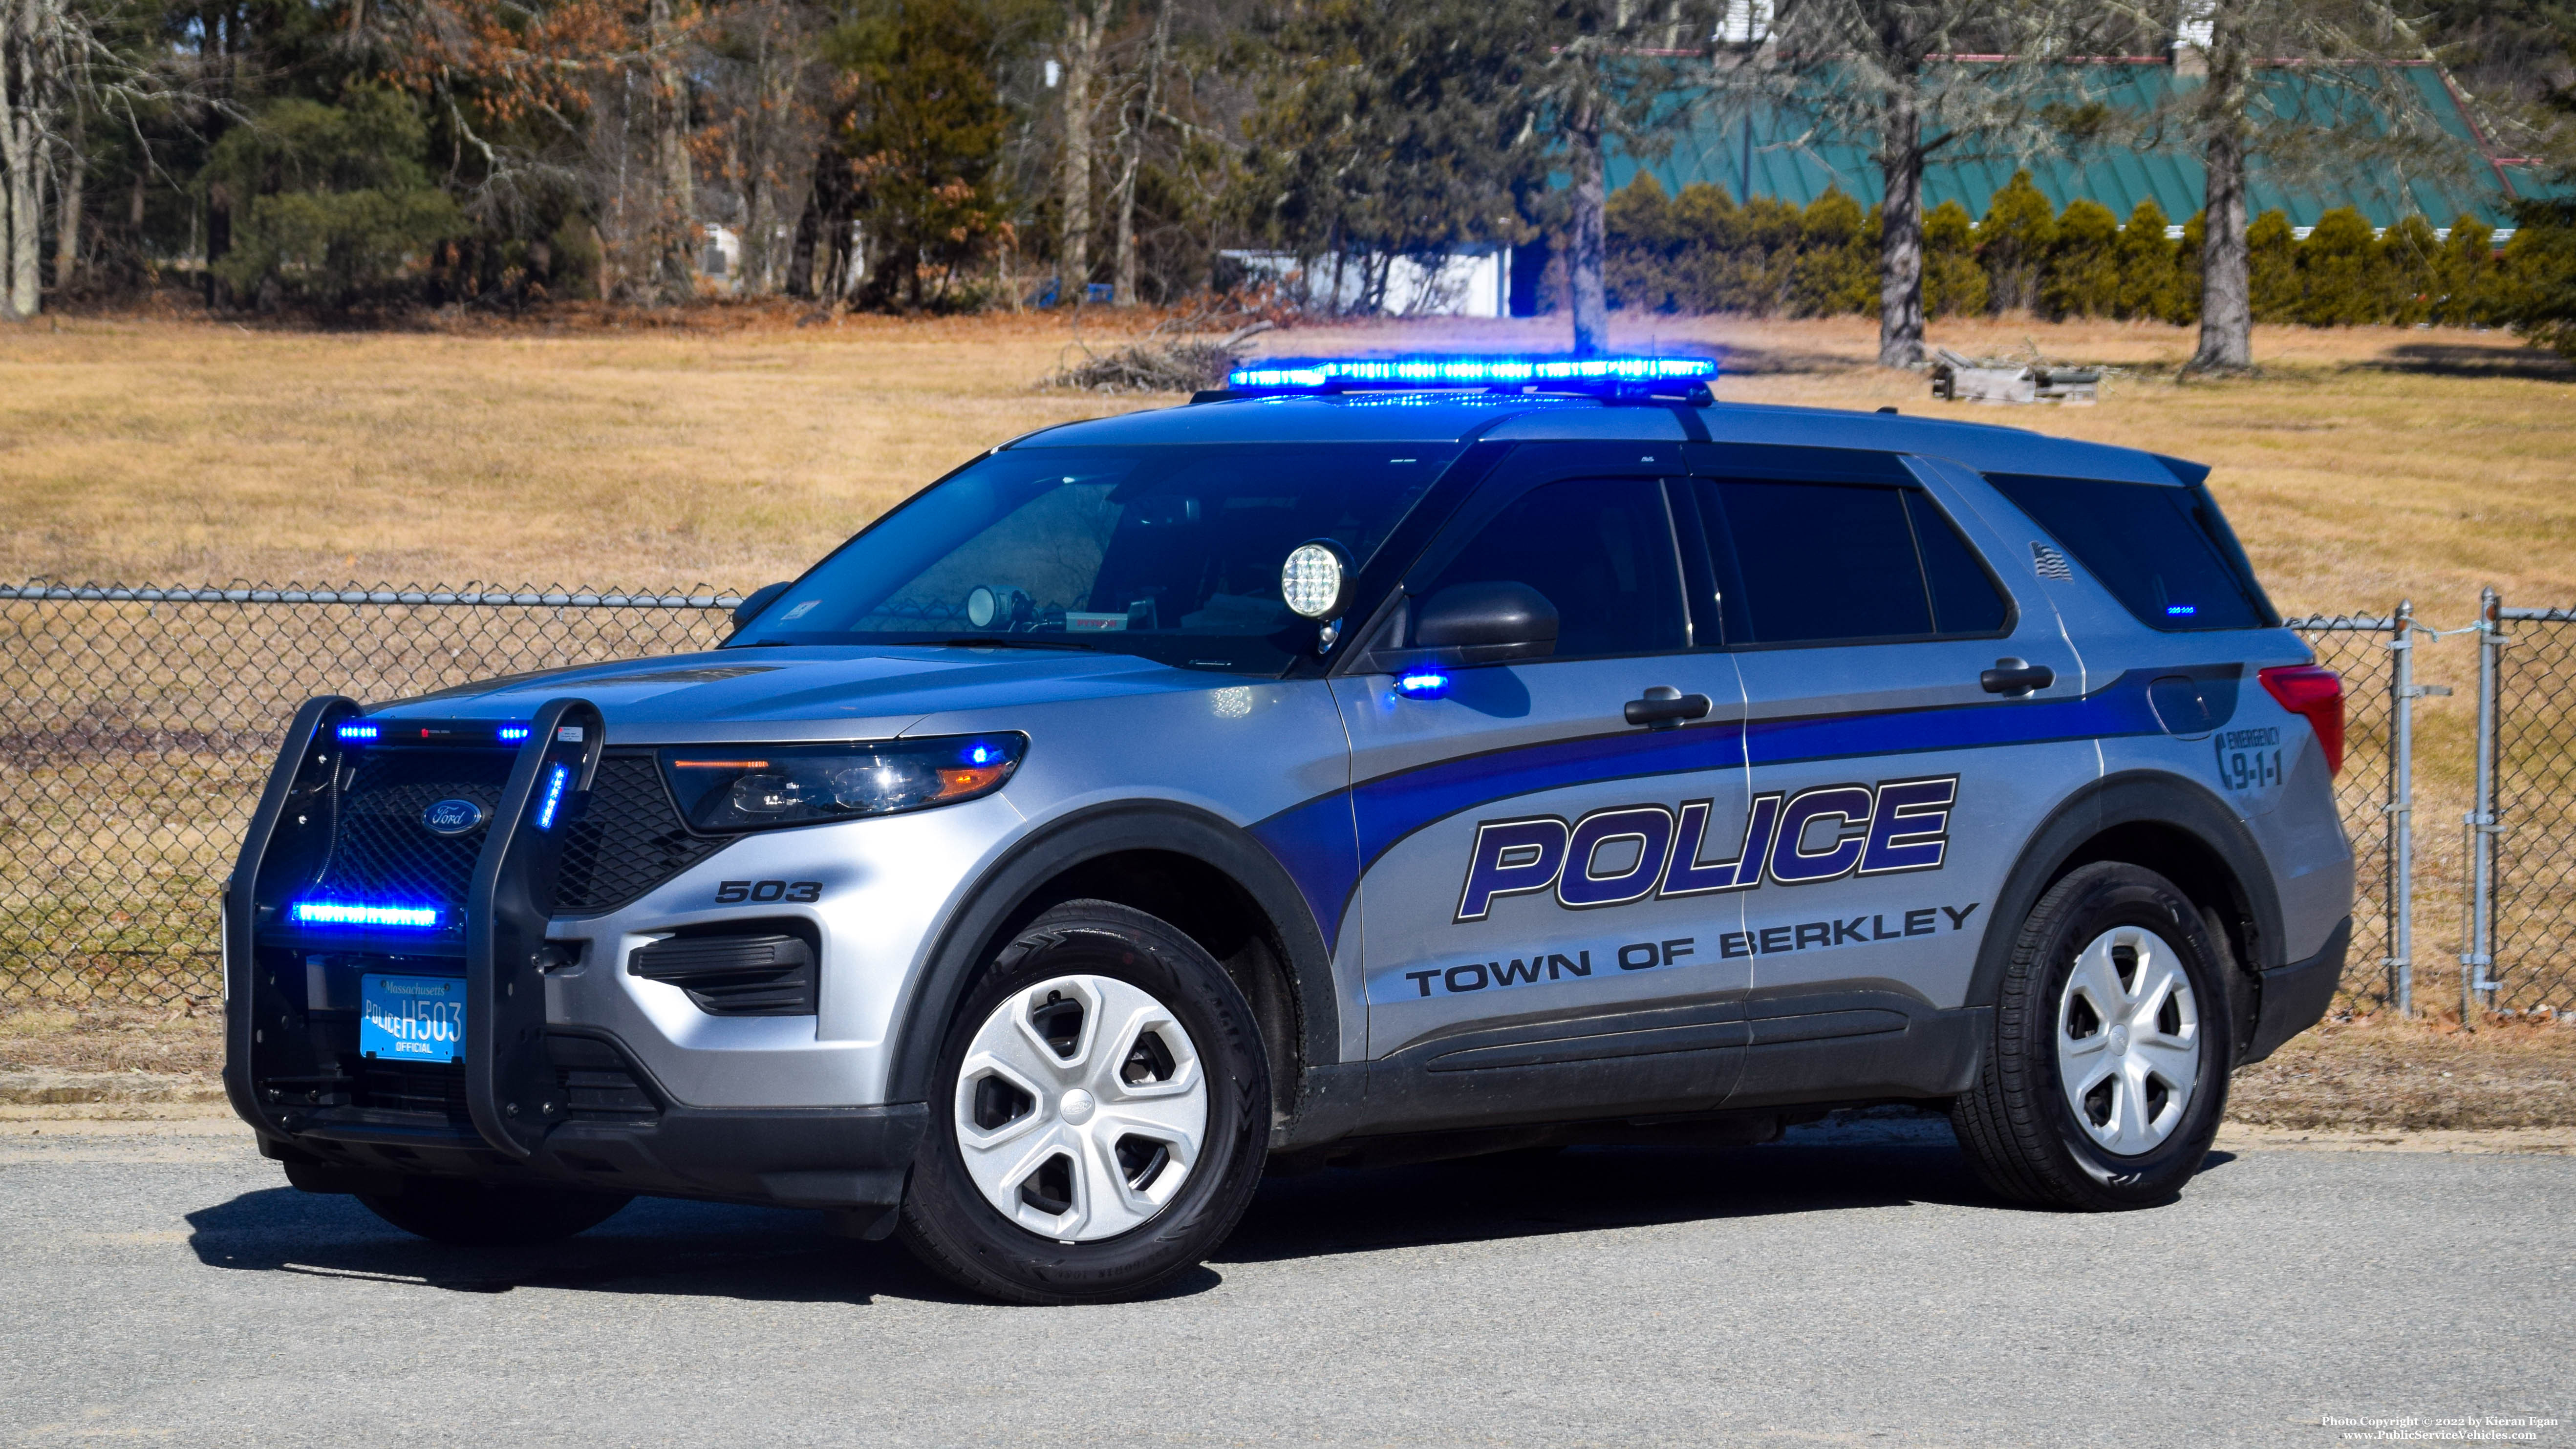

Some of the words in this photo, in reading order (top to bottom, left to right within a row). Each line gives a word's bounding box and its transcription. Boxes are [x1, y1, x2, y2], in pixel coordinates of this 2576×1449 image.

[2232, 749, 2282, 789] 9-1-1
[432, 805, 465, 825] Ford
[1452, 772, 1961, 924] POLICE
[715, 880, 823, 903] 503
[1406, 950, 1591, 997] TOWN
[1618, 938, 1695, 972] OF
[1720, 902, 1980, 959] BERKLEY
[385, 980, 445, 997] Massachusetts
[366, 999, 401, 1039] POLICE
[402, 1000, 461, 1042] H503
[396, 1042, 433, 1054] OFFICIAL
